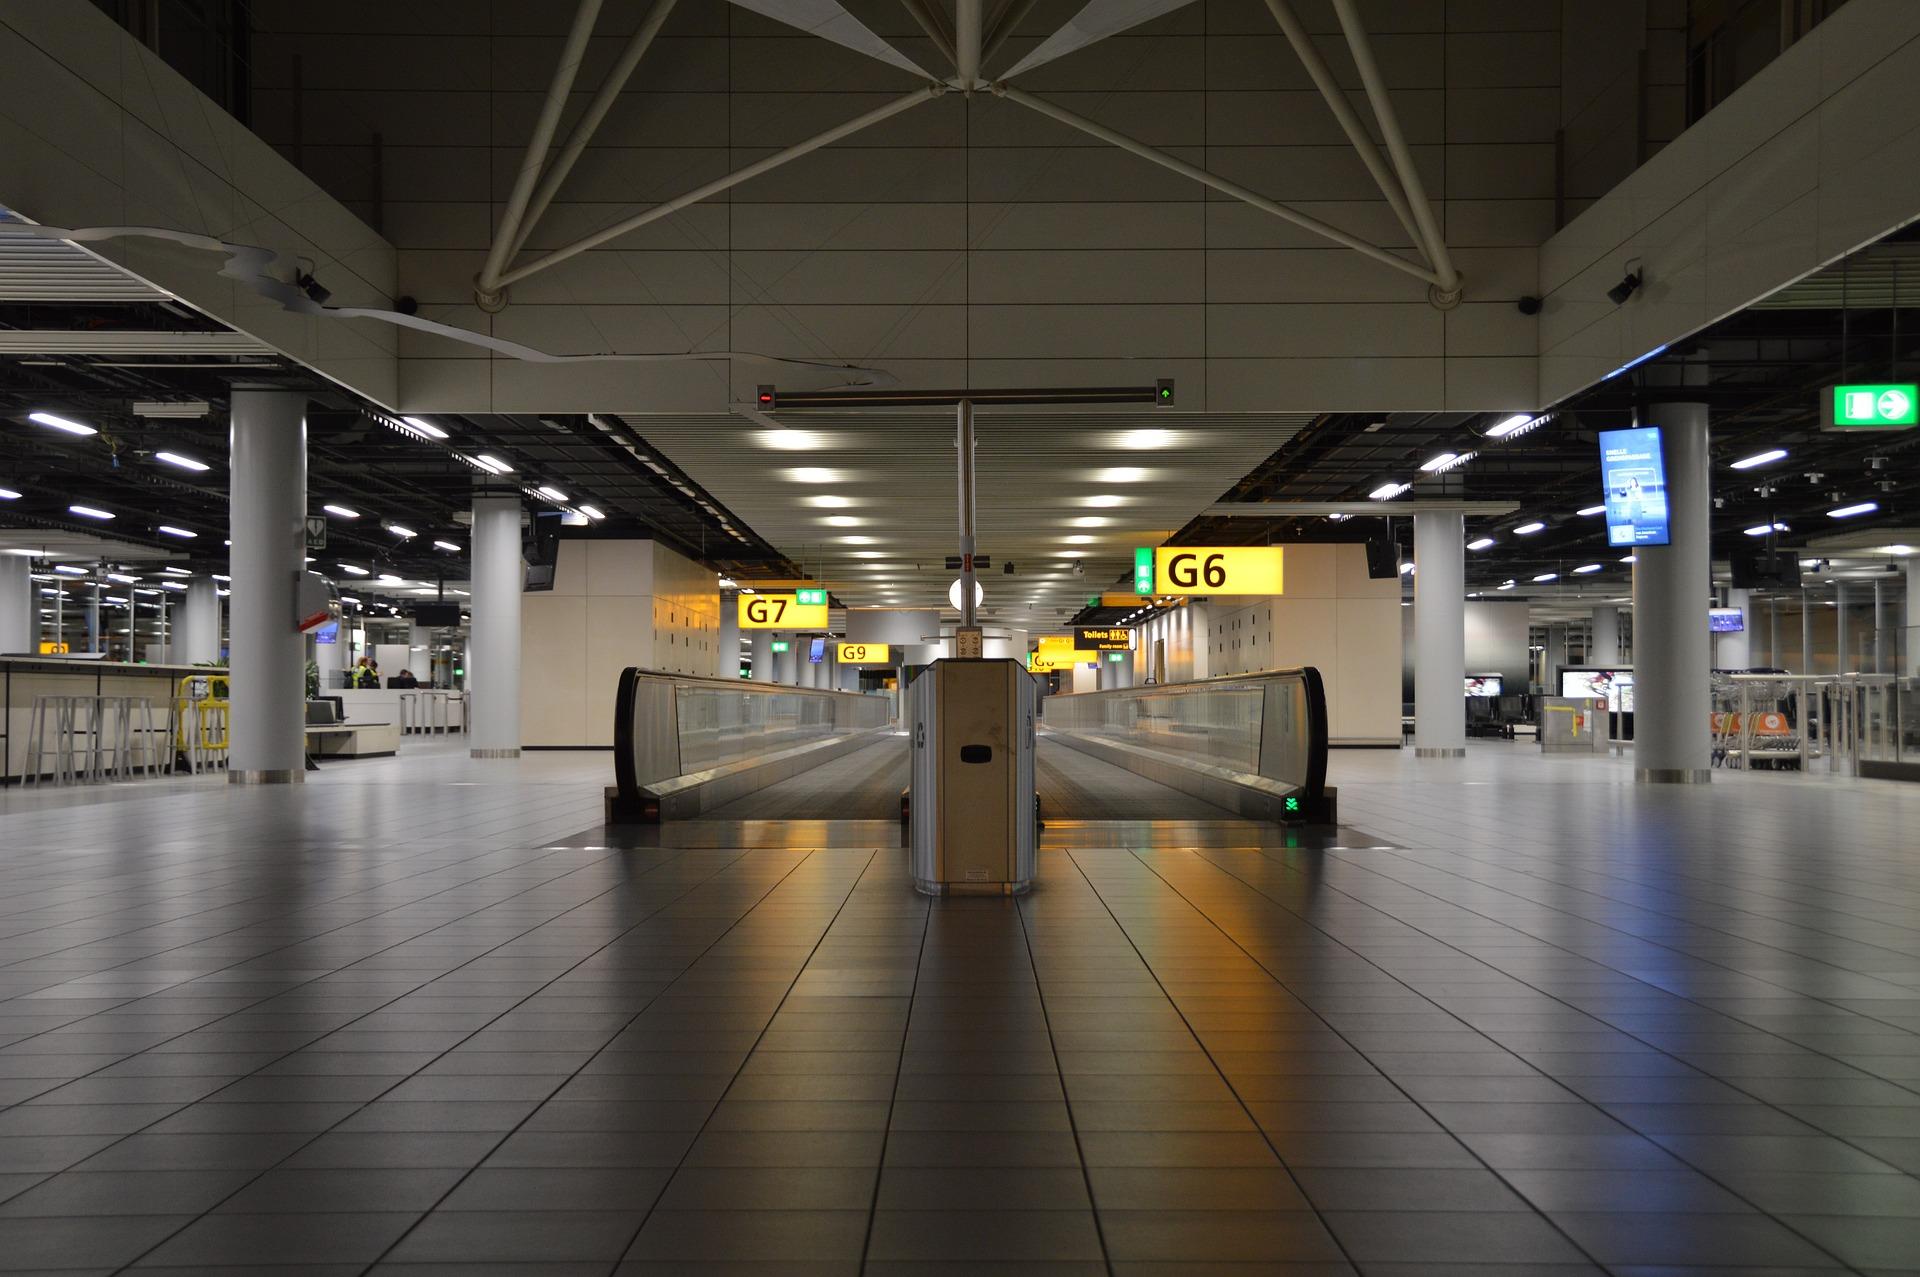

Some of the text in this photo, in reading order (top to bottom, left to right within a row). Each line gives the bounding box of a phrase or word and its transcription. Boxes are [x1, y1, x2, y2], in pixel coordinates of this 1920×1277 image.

[1168, 553, 1226, 588] G6
[747, 599, 787, 624] G7
[1083, 630, 1108, 639] Toilets
[843, 645, 866, 660] G9
